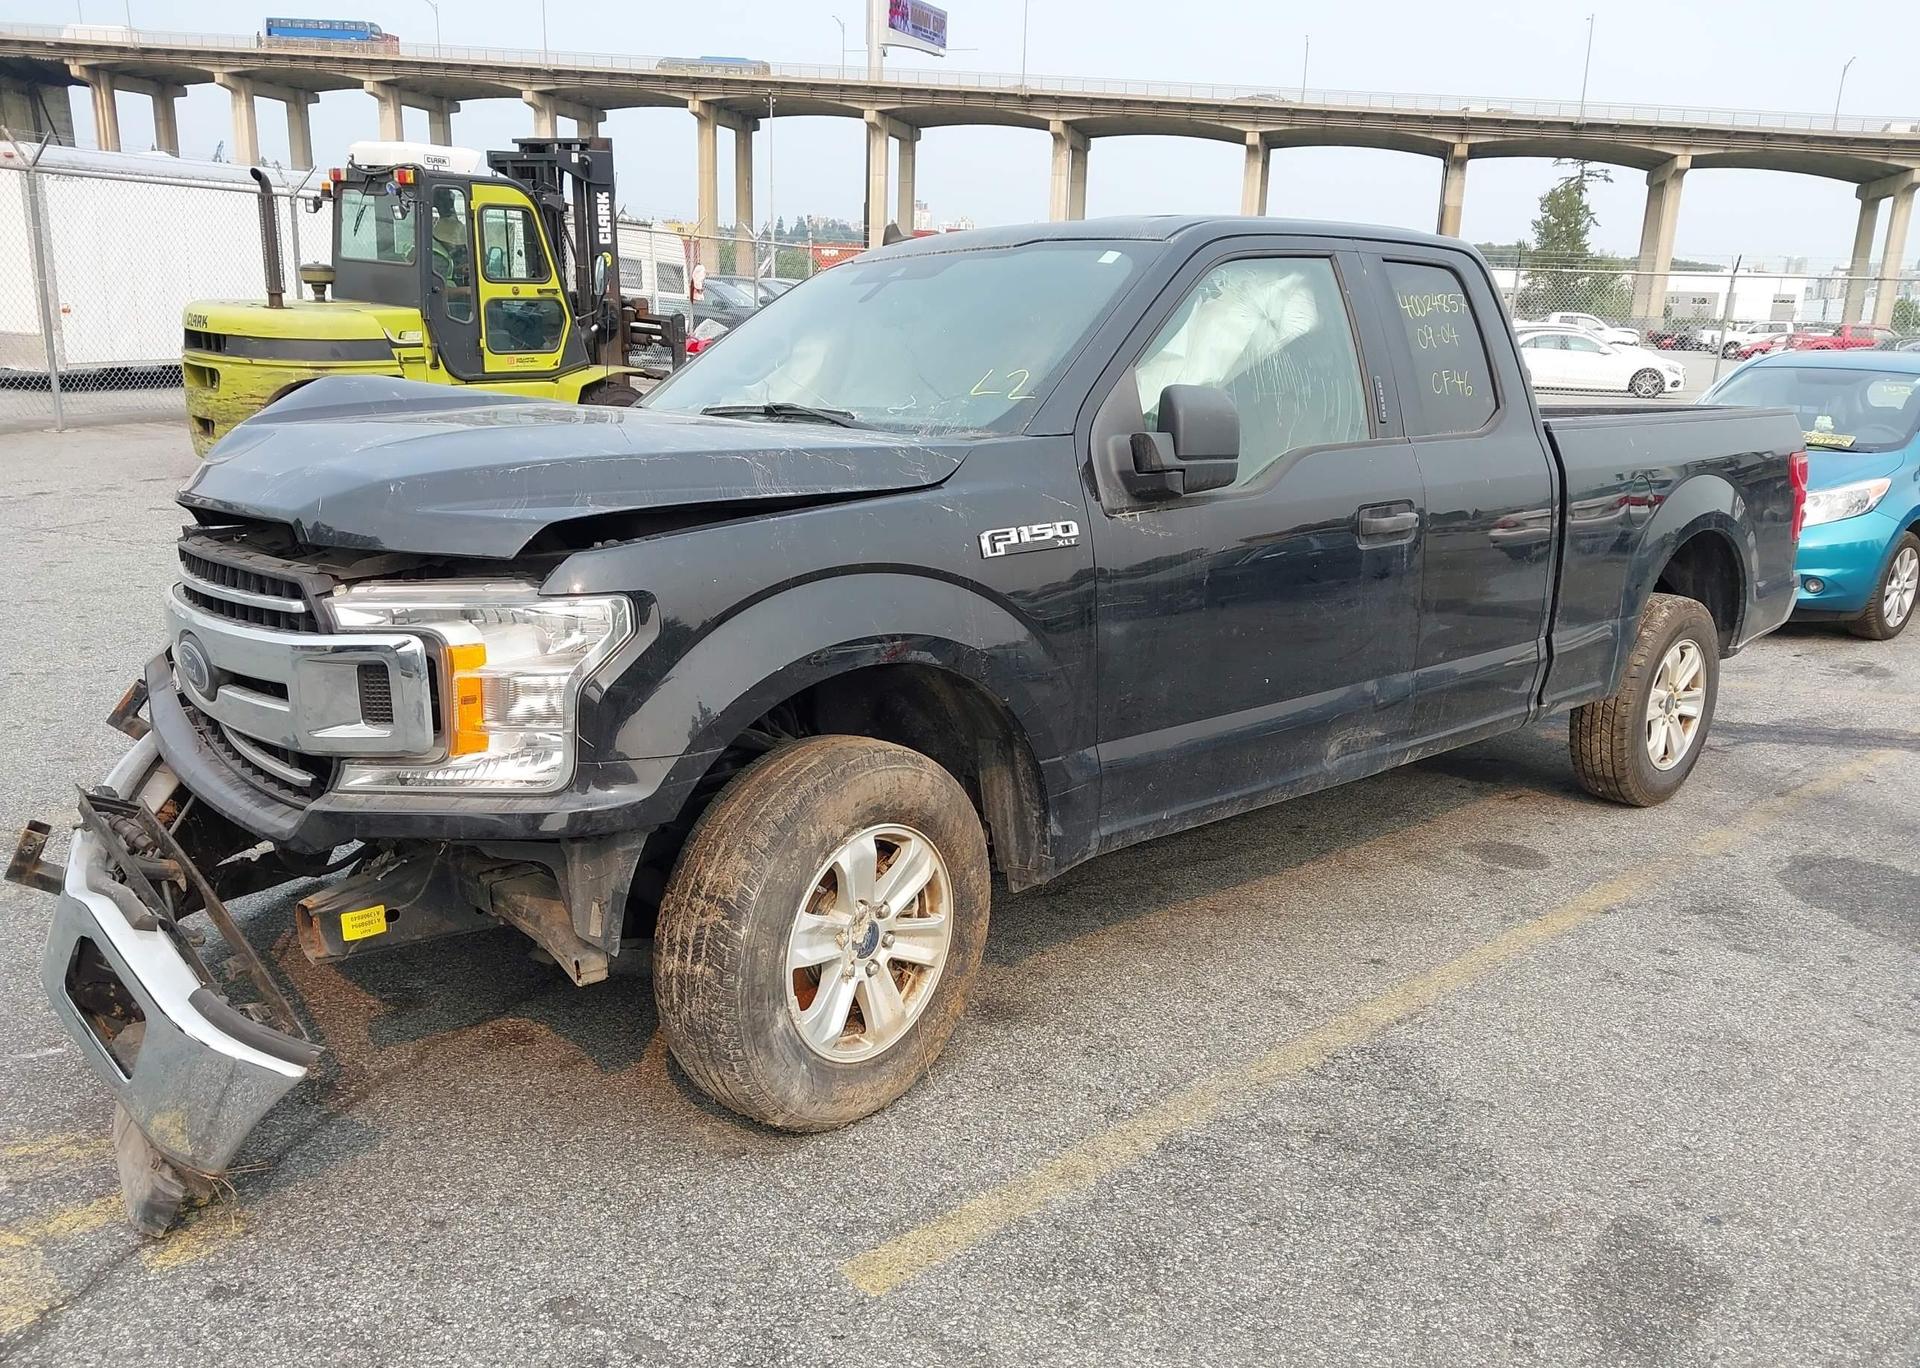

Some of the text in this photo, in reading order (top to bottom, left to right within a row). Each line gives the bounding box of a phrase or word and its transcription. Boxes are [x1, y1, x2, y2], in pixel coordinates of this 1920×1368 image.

[426, 156, 448, 165] CLARK
[596, 191, 612, 244] CLARK
[1397, 292, 1467, 319] 40024857
[186, 312, 209, 328] CLARK
[1056, 537, 1077, 547] XLT
